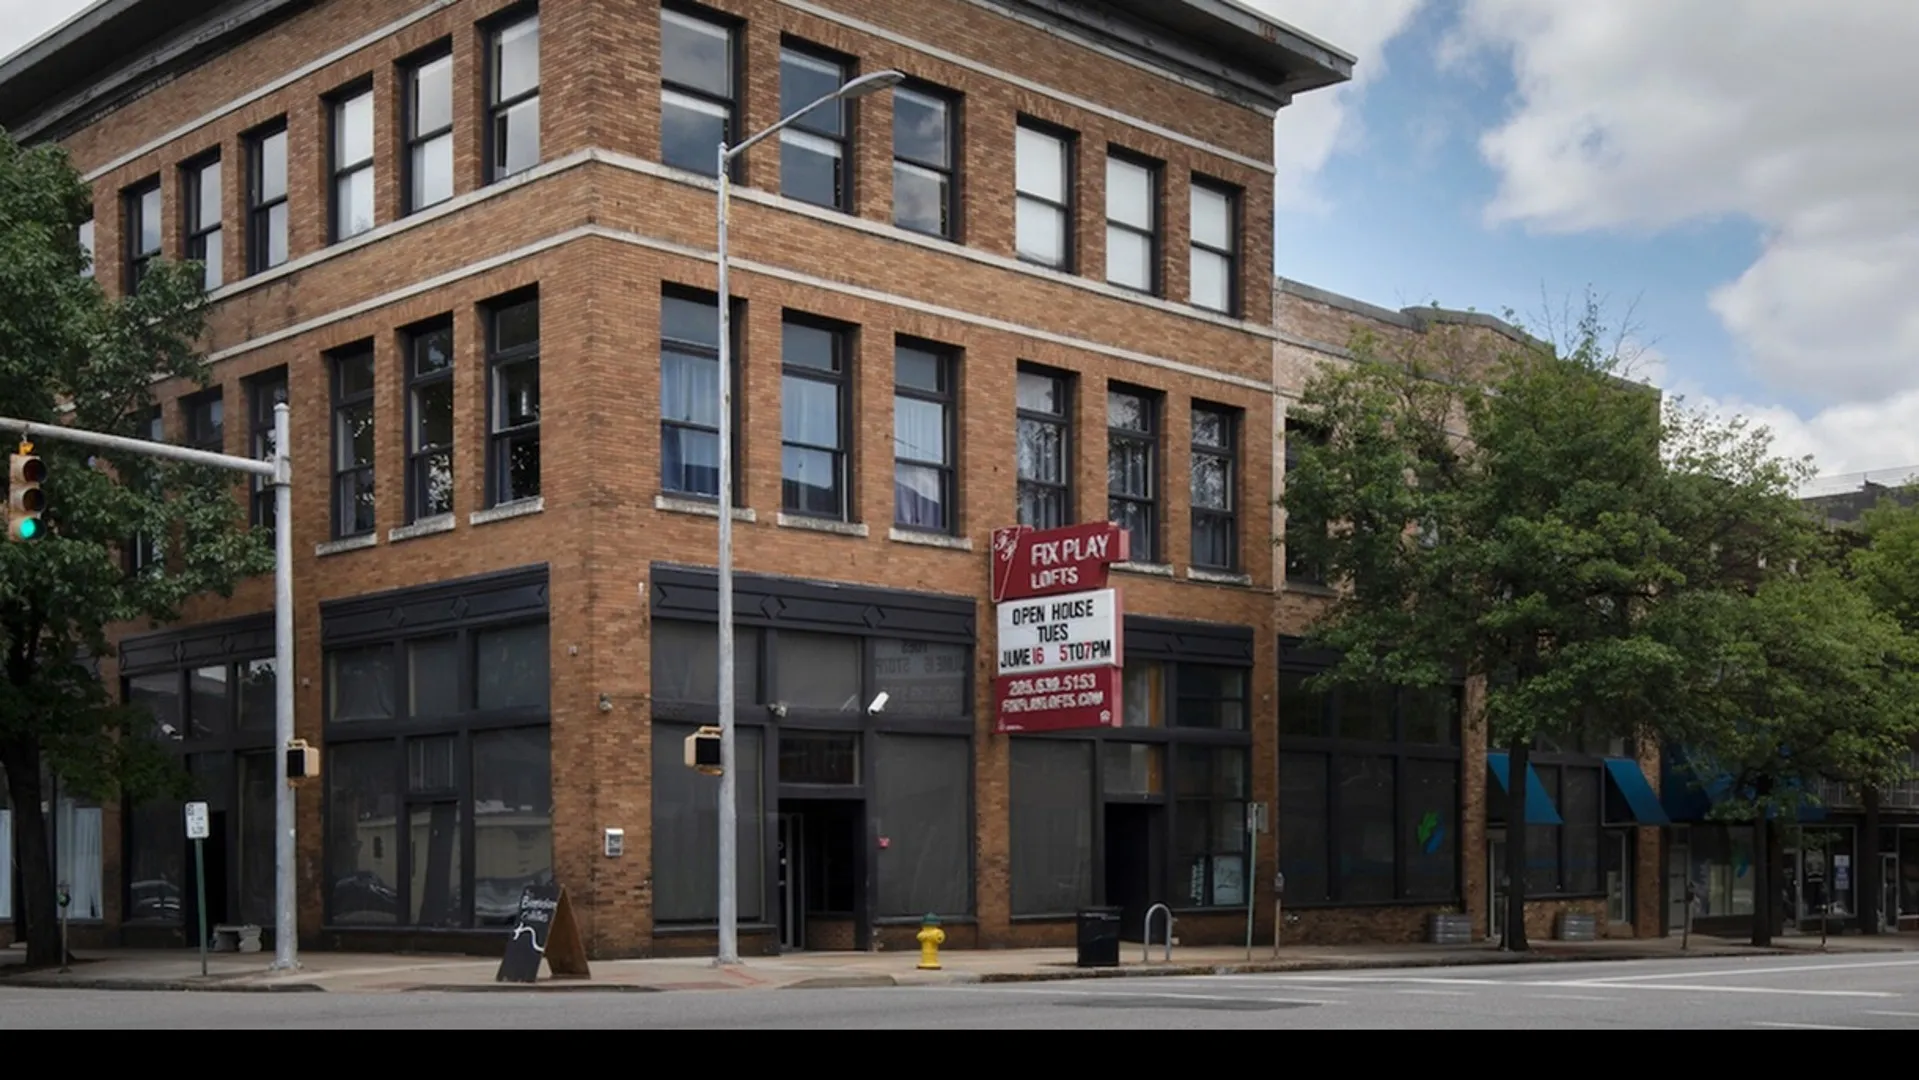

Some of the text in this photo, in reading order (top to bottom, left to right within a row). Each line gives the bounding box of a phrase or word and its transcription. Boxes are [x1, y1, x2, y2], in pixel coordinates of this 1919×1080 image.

[1031, 533, 1111, 567] FIX PLAY
[1030, 566, 1079, 589] LOFTS
[1012, 599, 1094, 625] OPEN HOUSE
[1037, 624, 1068, 642] TUES
[1001, 648, 1030, 667] JUNE
[1032, 647, 1044, 664] 16
